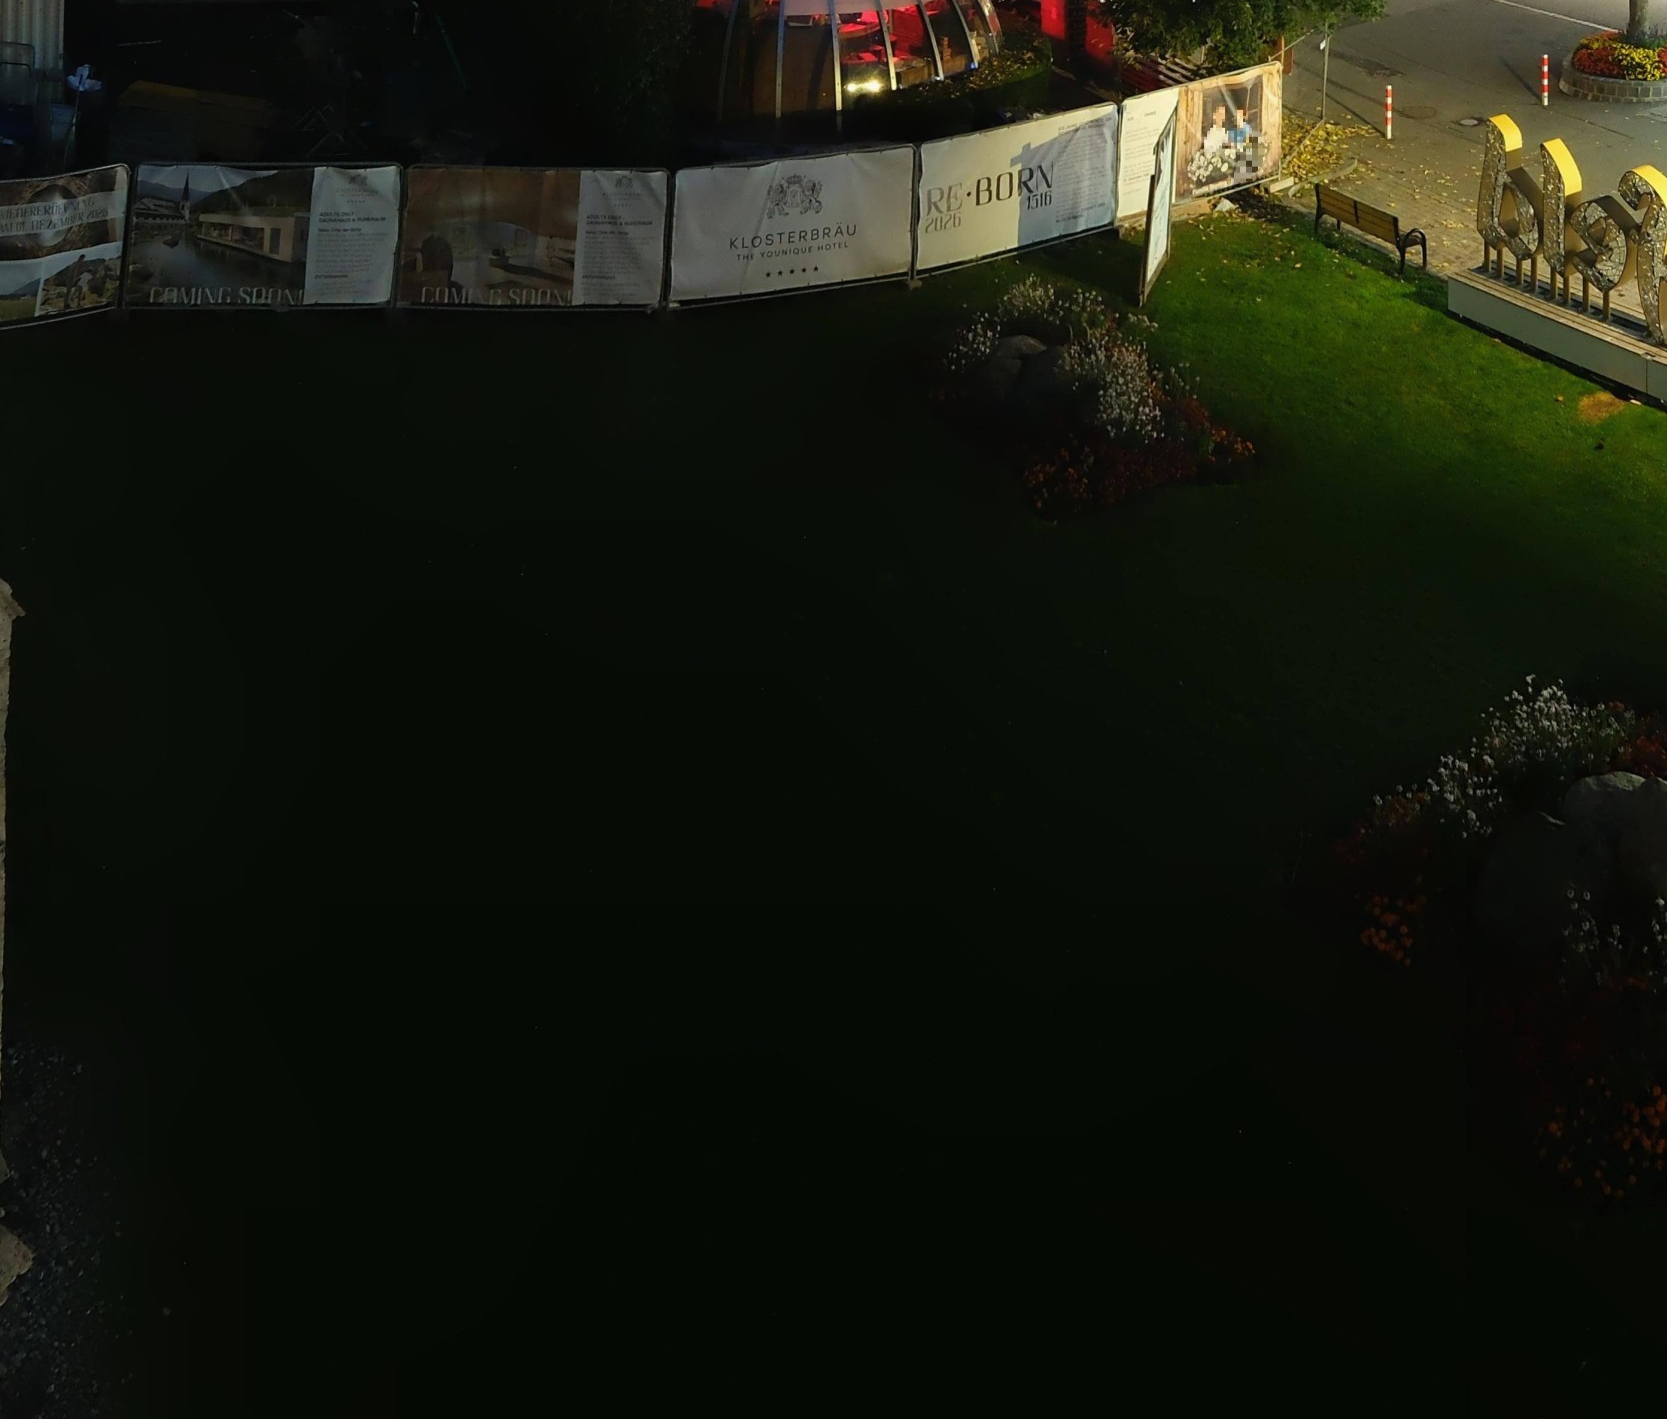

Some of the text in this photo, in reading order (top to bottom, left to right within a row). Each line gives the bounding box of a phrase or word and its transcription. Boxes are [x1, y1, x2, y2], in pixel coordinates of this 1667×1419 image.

[1027, 190, 1053, 211] 1516
[925, 211, 962, 234] 2026
[729, 221, 857, 250] KLOSTERBRÄU
[736, 241, 849, 261] THE YOUNIQUE HOTEL
